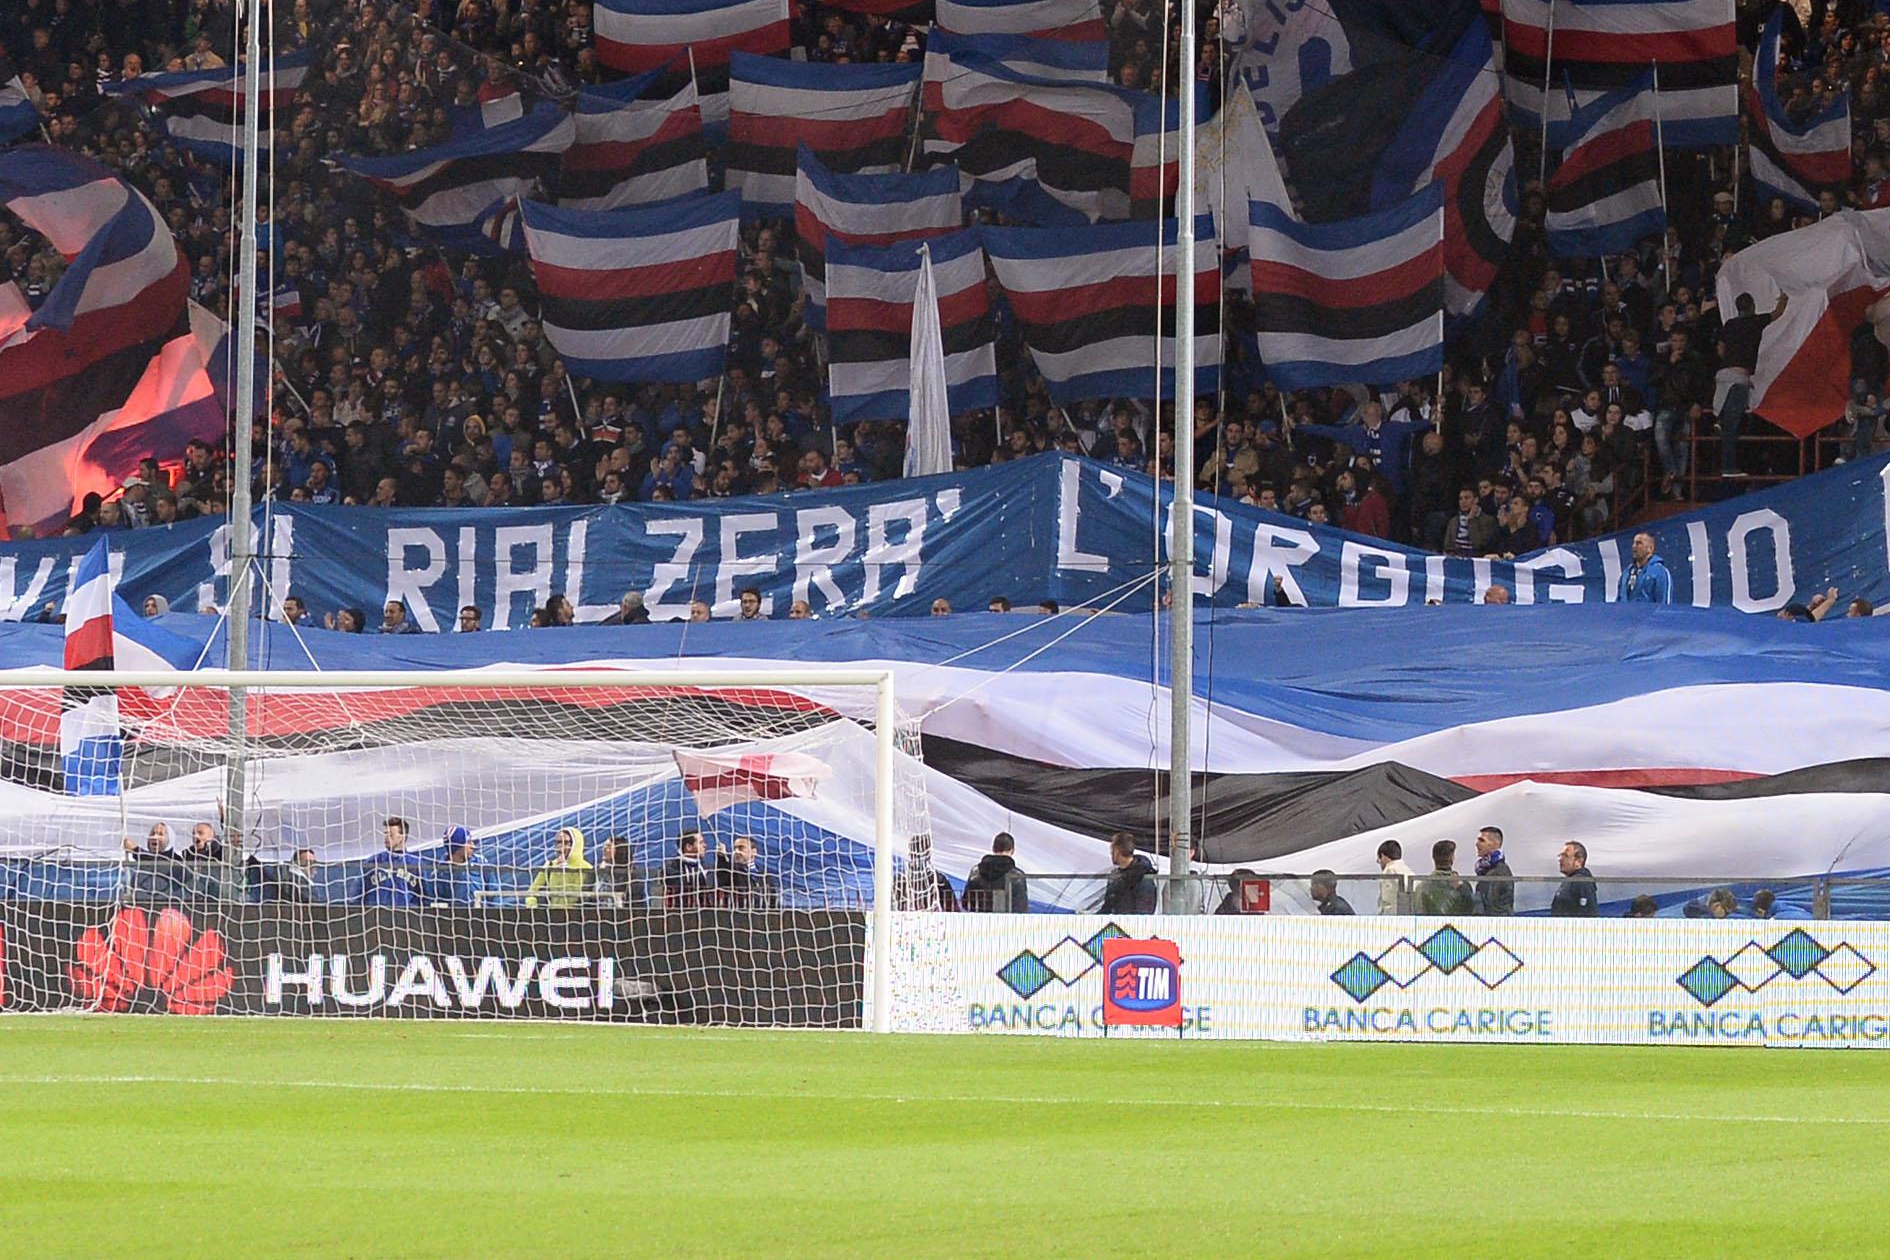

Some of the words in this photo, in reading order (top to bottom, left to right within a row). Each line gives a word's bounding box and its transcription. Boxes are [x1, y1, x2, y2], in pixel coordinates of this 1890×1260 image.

[386, 488, 962, 633] RIALZERA'
[265, 952, 617, 1010] HUAWEI
[1138, 967, 1170, 1001] TIM
[969, 1002, 1082, 1031] BANCA
[1304, 1005, 1418, 1033] BANCA
[1427, 1006, 1553, 1036] CARIGE
[1649, 1009, 1763, 1039] BANCA
